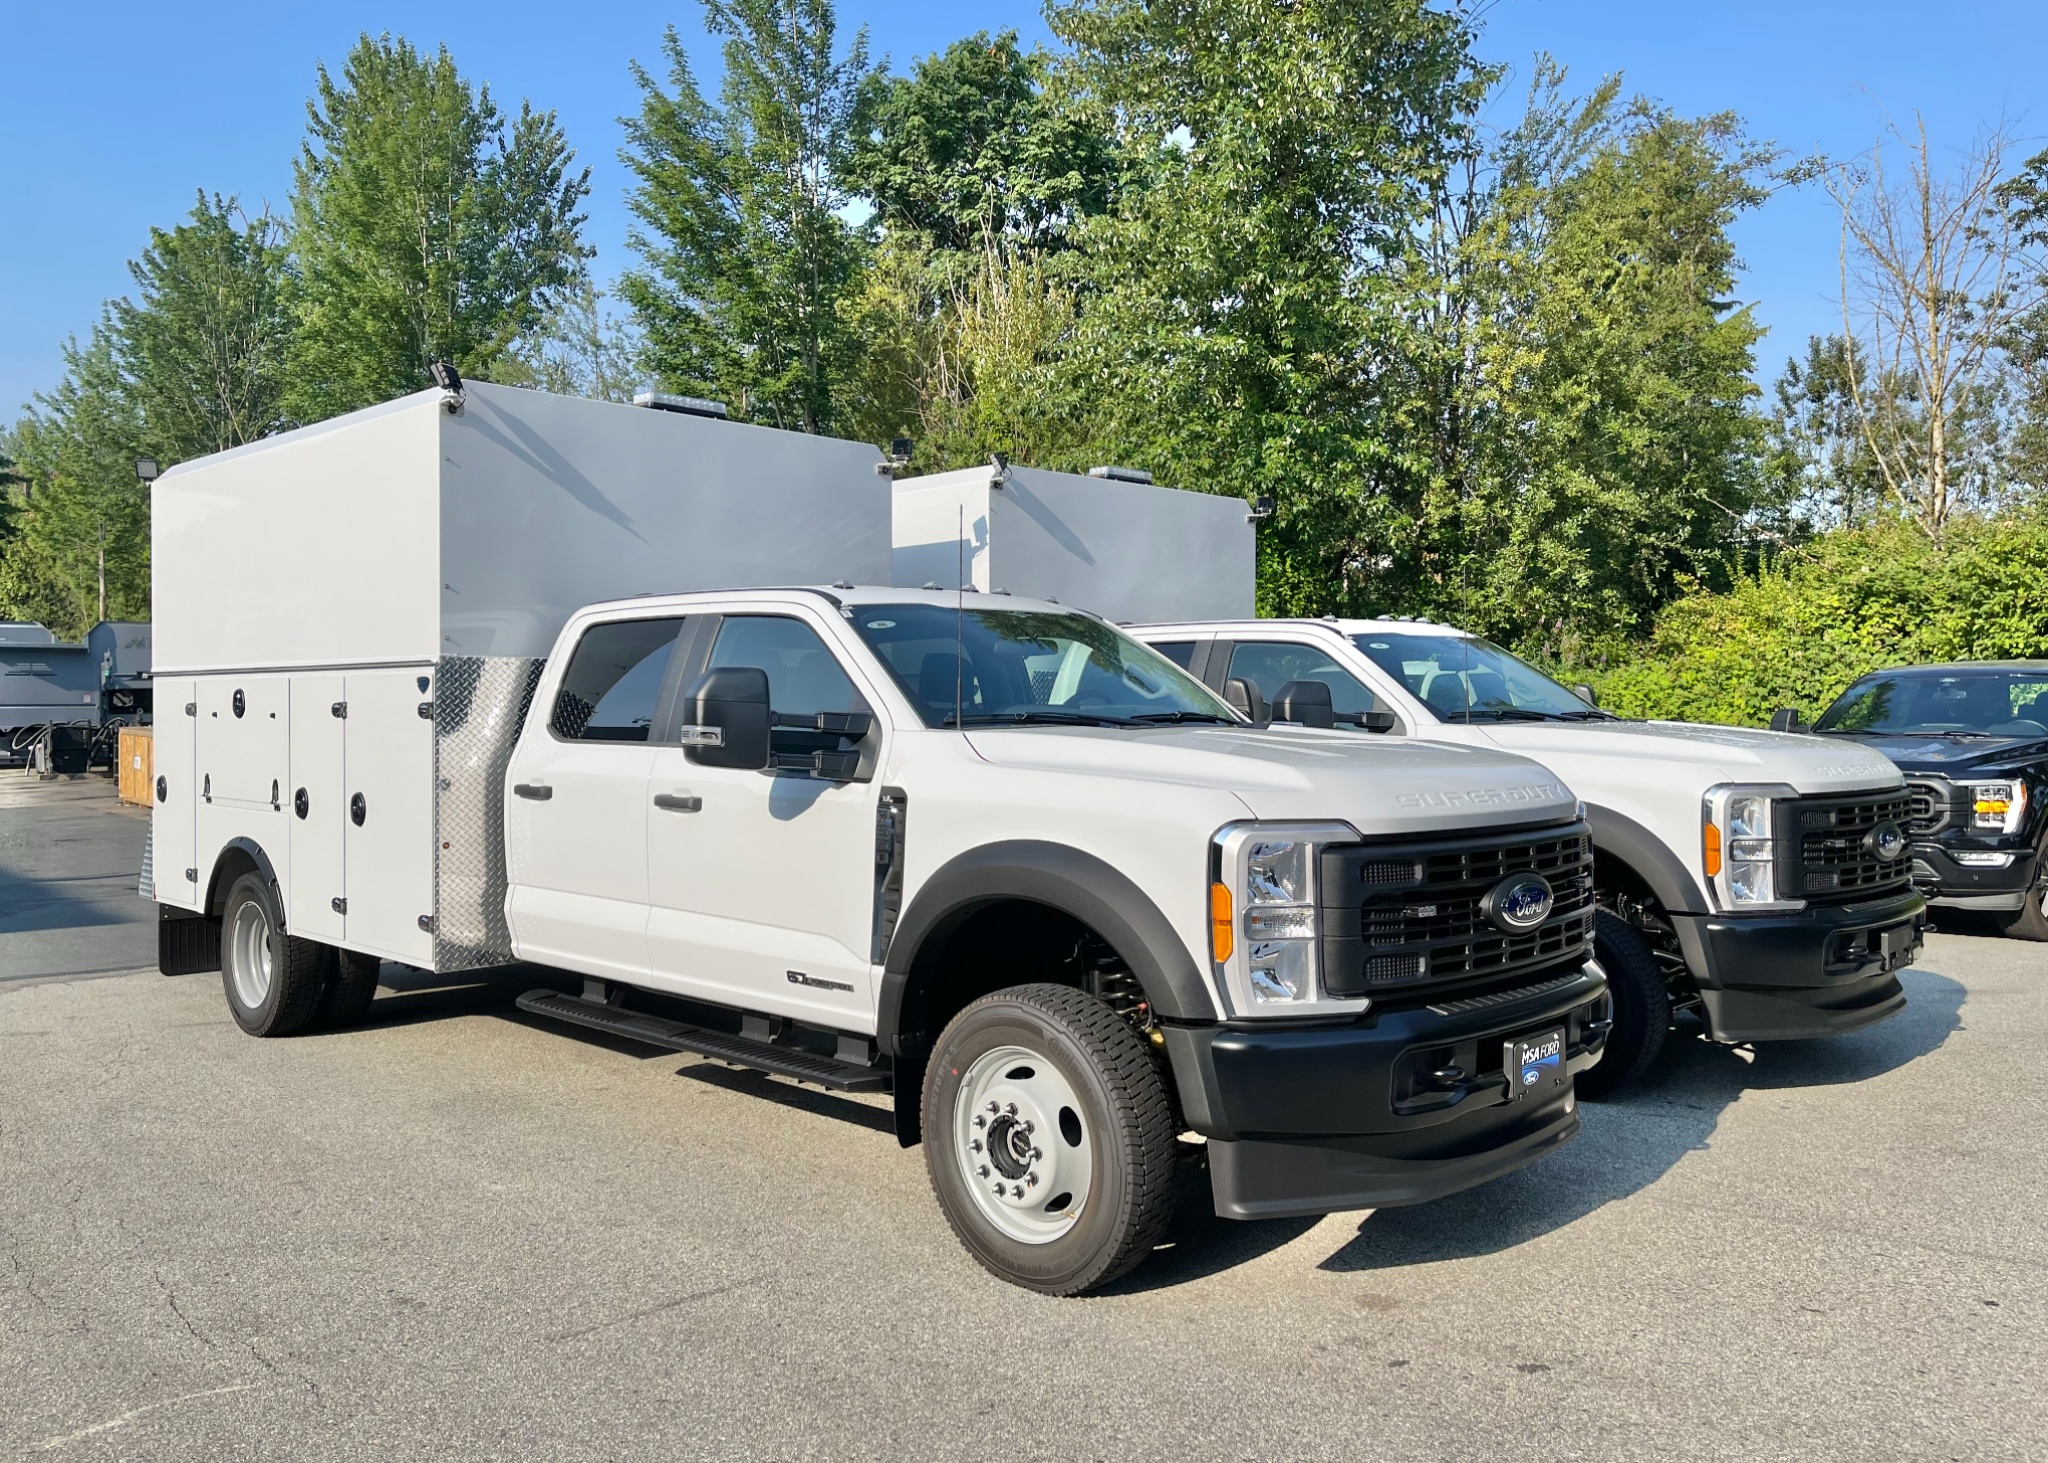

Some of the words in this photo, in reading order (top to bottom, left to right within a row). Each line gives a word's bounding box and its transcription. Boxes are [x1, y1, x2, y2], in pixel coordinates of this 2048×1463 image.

[1396, 789, 1509, 808] SUPER
[1516, 890, 1545, 917] Ford
[1521, 1047, 1540, 1066] MSA
[1540, 1040, 1560, 1059] FORD
